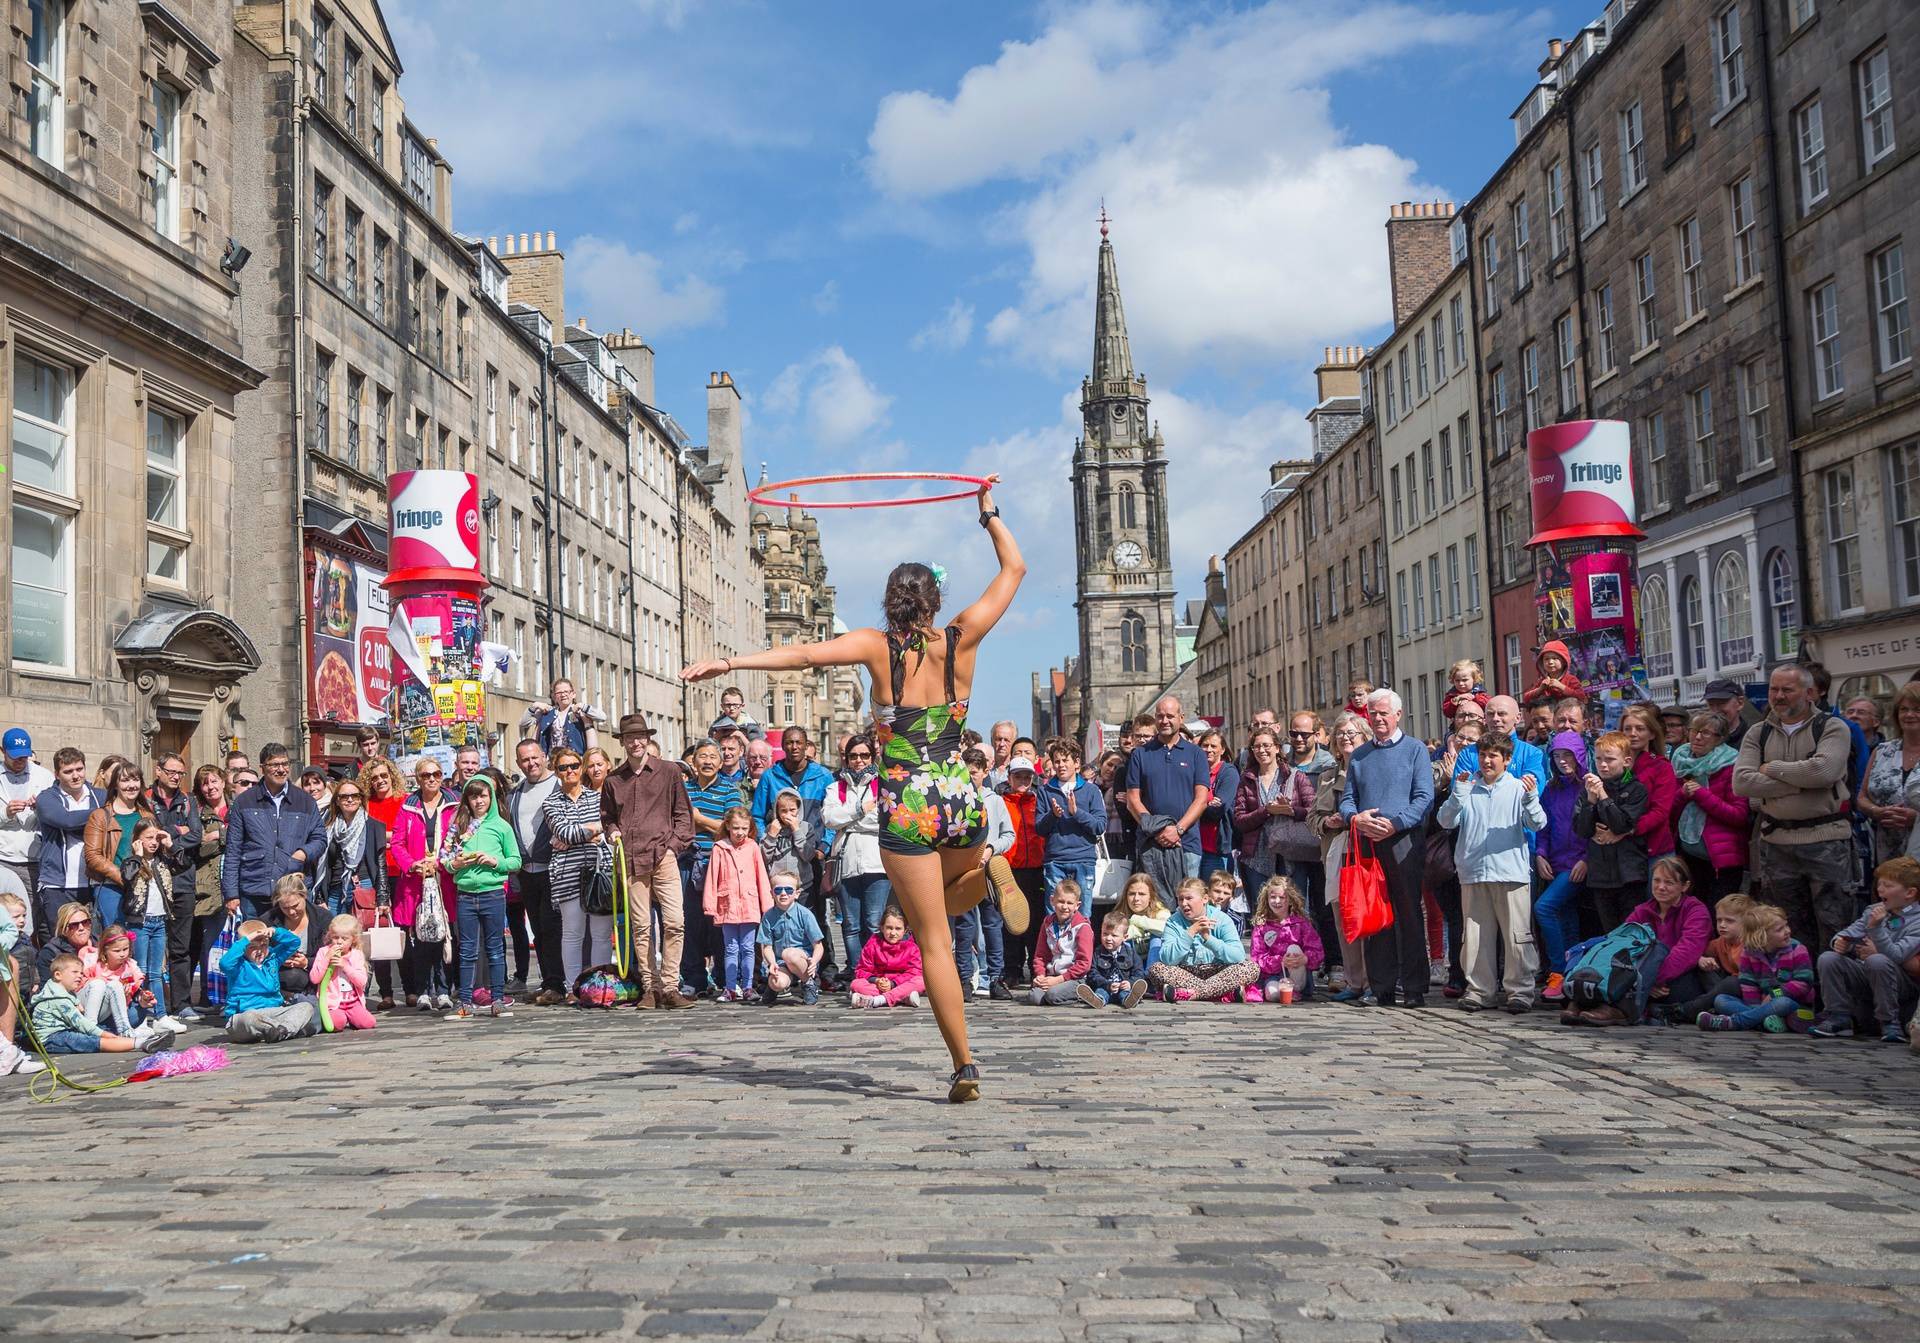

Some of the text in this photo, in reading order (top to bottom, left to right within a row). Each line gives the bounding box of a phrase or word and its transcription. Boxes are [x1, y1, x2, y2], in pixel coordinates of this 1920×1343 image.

[1571, 462, 1622, 484] fringe
[396, 509, 443, 530] fringe
[364, 640, 372, 666] 2
[1844, 643, 1887, 659] TASTE
[1891, 639, 1909, 653] OF
[14, 738, 26, 746] NY
